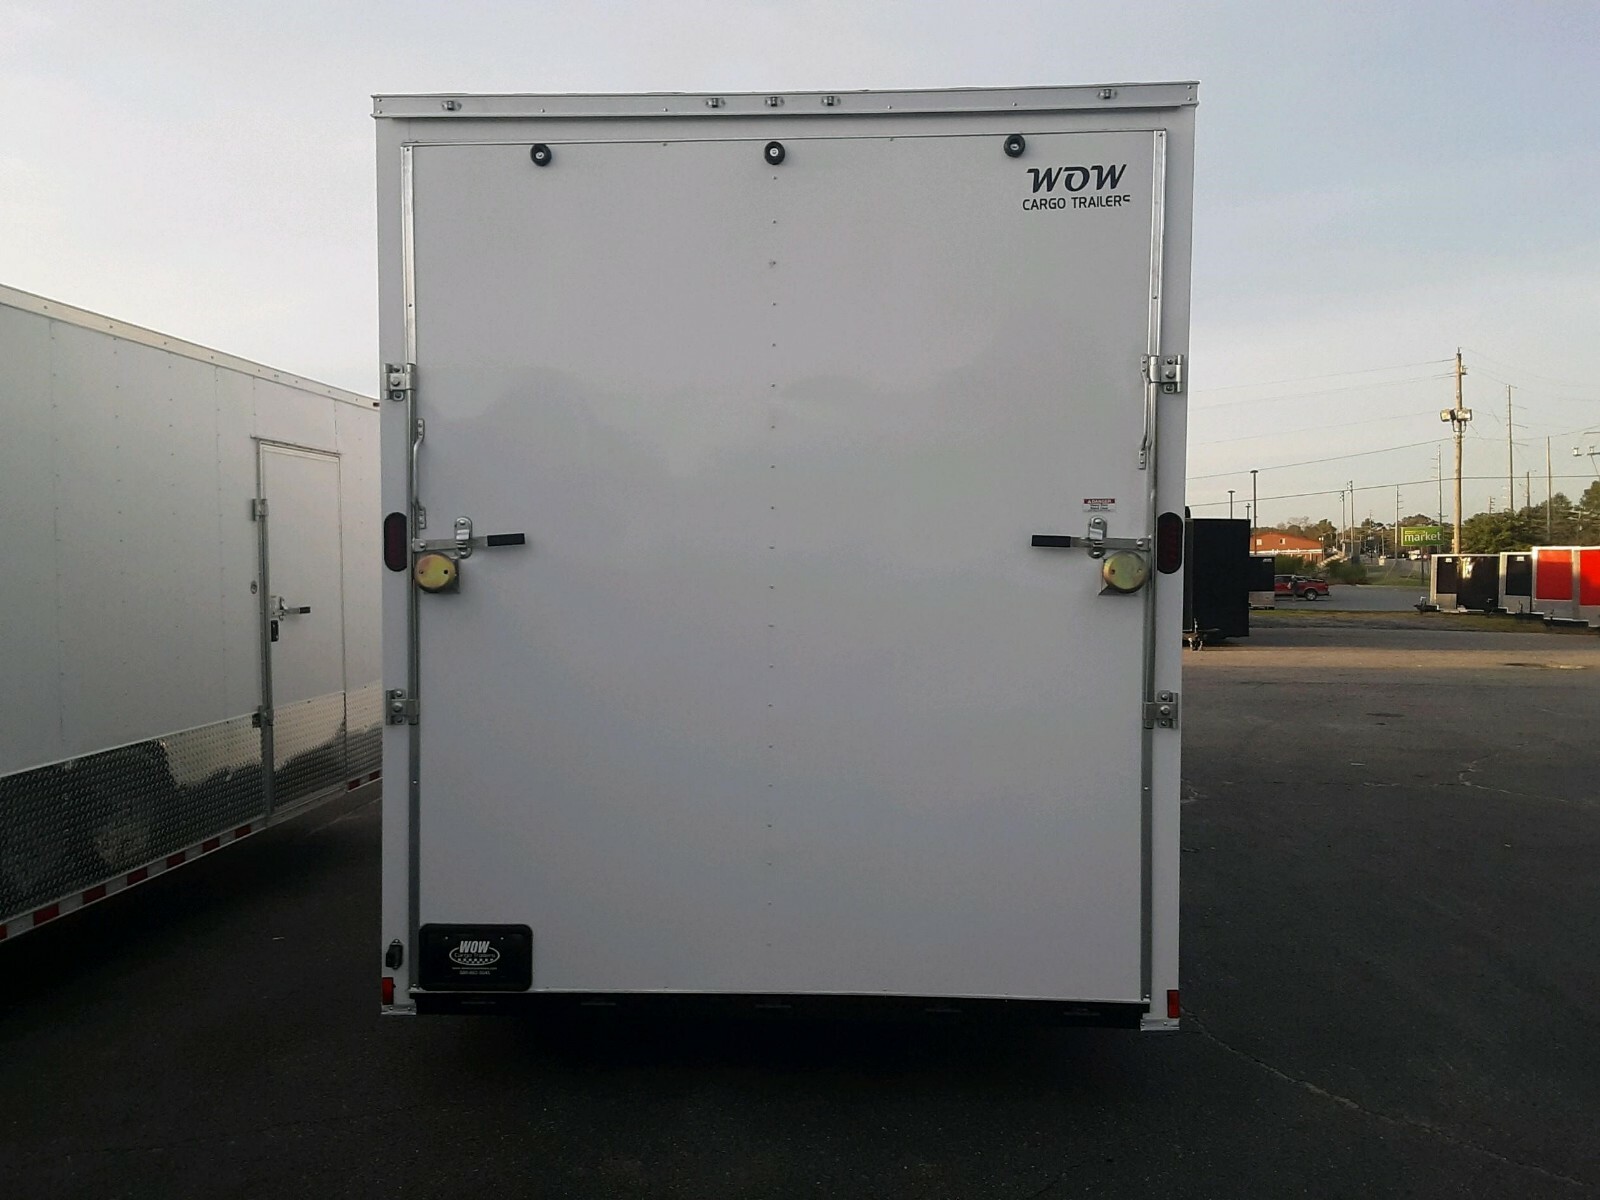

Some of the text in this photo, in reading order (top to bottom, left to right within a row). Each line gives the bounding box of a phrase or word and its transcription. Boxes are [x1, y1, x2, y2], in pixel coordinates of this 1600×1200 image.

[1026, 164, 1127, 193] WOW
[1022, 197, 1066, 210] CARGO
[1404, 531, 1441, 542] market
[460, 941, 490, 953] WOW
